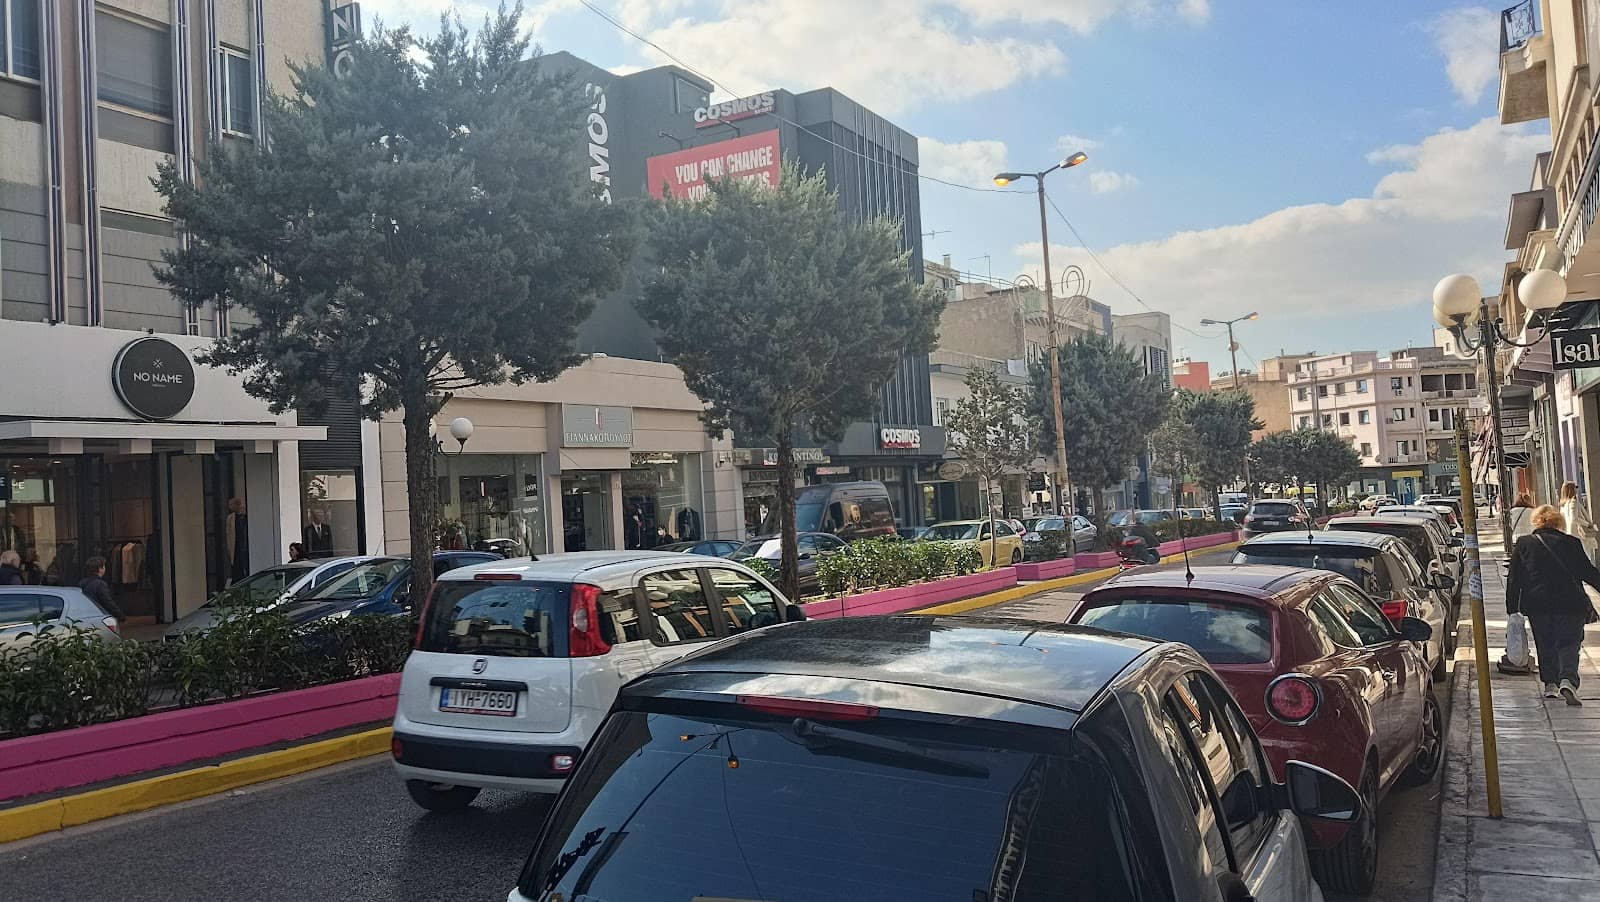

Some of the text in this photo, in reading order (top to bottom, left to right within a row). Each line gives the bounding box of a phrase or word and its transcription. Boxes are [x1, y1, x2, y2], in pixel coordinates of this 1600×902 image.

[694, 92, 775, 122] COSMOS
[675, 146, 773, 185] YOU CAN CHANGE
[133, 372, 183, 384] NO NAME
[881, 428, 920, 443] COSMOS
